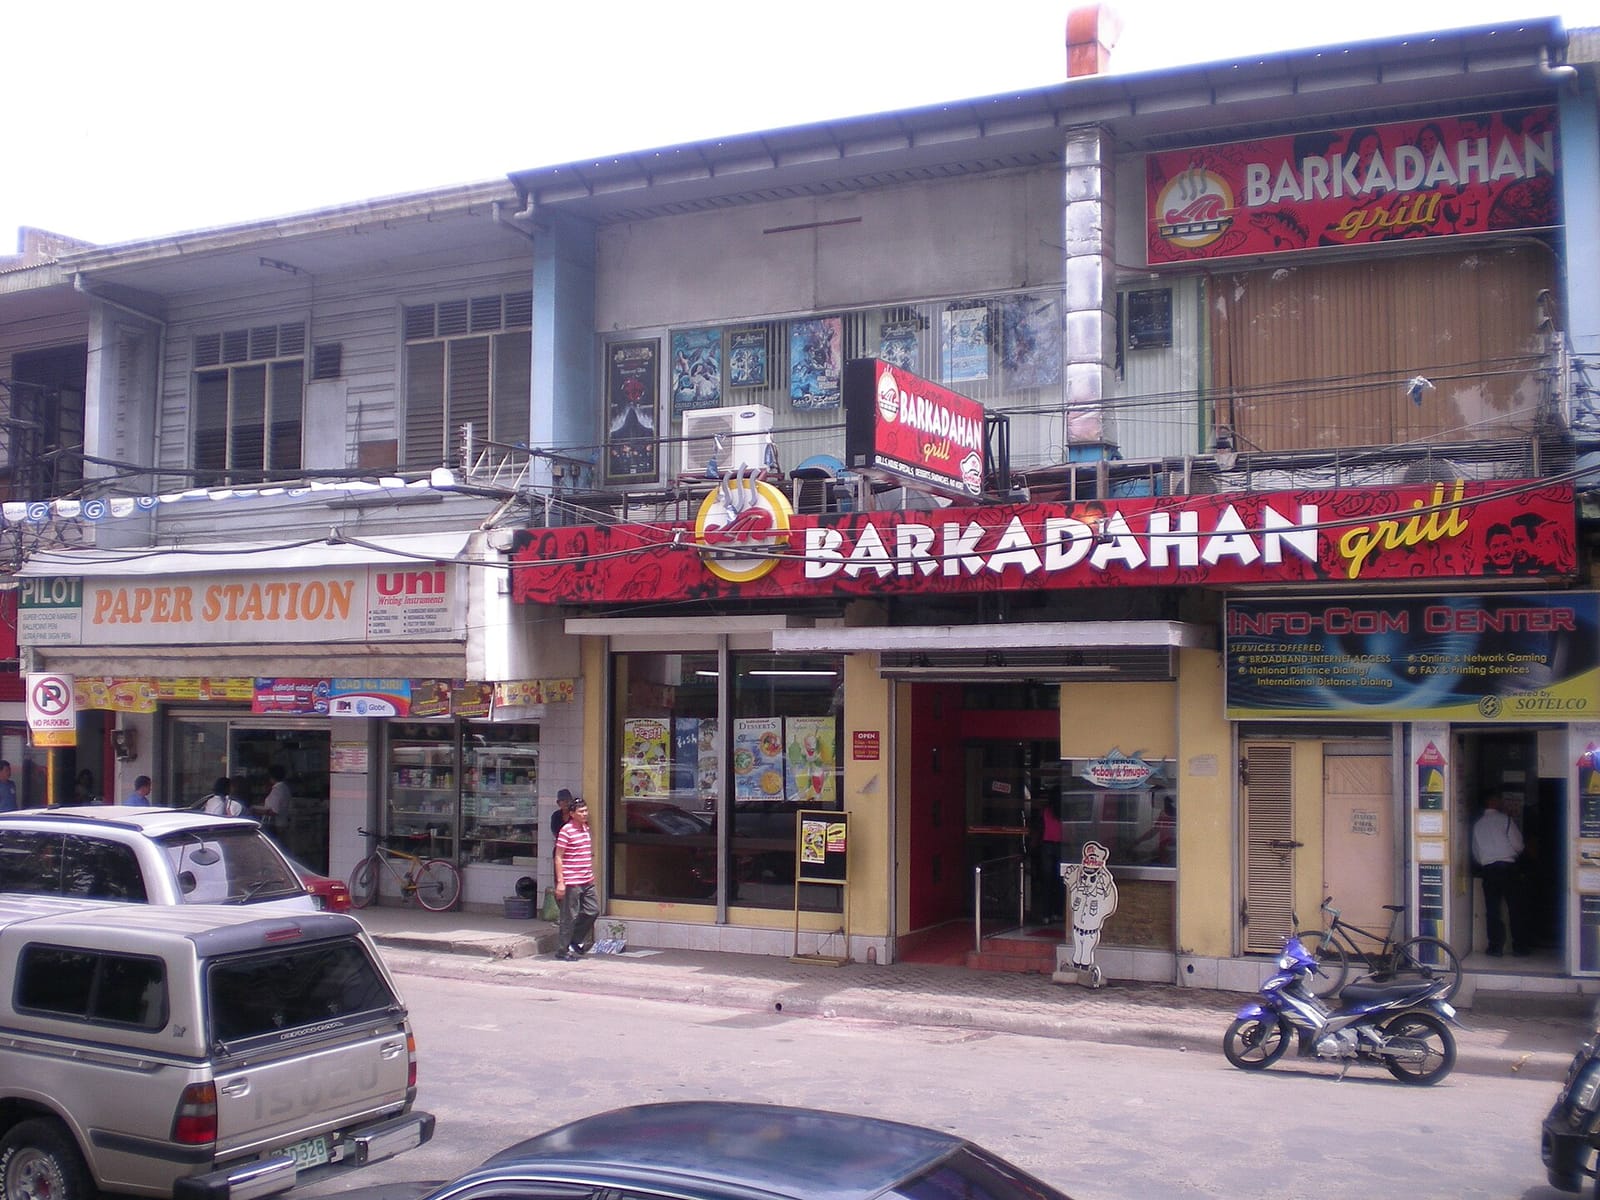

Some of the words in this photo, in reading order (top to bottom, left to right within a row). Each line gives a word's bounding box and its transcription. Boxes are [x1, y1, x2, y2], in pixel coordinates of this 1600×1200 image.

[1246, 130, 1556, 208] BARKADAHAN
[1335, 192, 1440, 239] grill
[899, 390, 982, 452] BARKADAHAN
[923, 438, 951, 462] grill
[803, 503, 1320, 580] BARKADAHAN
[1338, 478, 1470, 580] grill
[376, 563, 447, 596] uni
[21, 576, 81, 605] PILOT
[92, 586, 193, 625] PAPER
[202, 580, 355, 622] STATION
[378, 596, 403, 607] Writing
[1231, 644, 1275, 652] SERVICES
[1279, 643, 1325, 652] OFFERED:
[1249, 655, 1308, 664] BROADBAND
[1310, 655, 1351, 663] INTERNET
[1353, 654, 1391, 663] ACCESS
[1419, 654, 1451, 663] Online
[1463, 653, 1504, 662] Network
[1506, 652, 1547, 664] Gaming
[1249, 666, 1288, 675] National
[1291, 666, 1330, 675] Distance
[1420, 666, 1439, 674] FAX
[1451, 665, 1487, 676] Printing
[1489, 665, 1530, 674] Services
[1257, 677, 1315, 686] International
[1318, 678, 1358, 686] Distance
[1360, 677, 1393, 688] Dialing
[1516, 698, 1587, 710] SOTELCO
[33, 719, 43, 727] NO
[43, 718, 70, 727] PARKING
[738, 721, 777, 730] DESSERTS
[634, 726, 663, 740] Feast!
[253, 1058, 379, 1121] ISUZU
